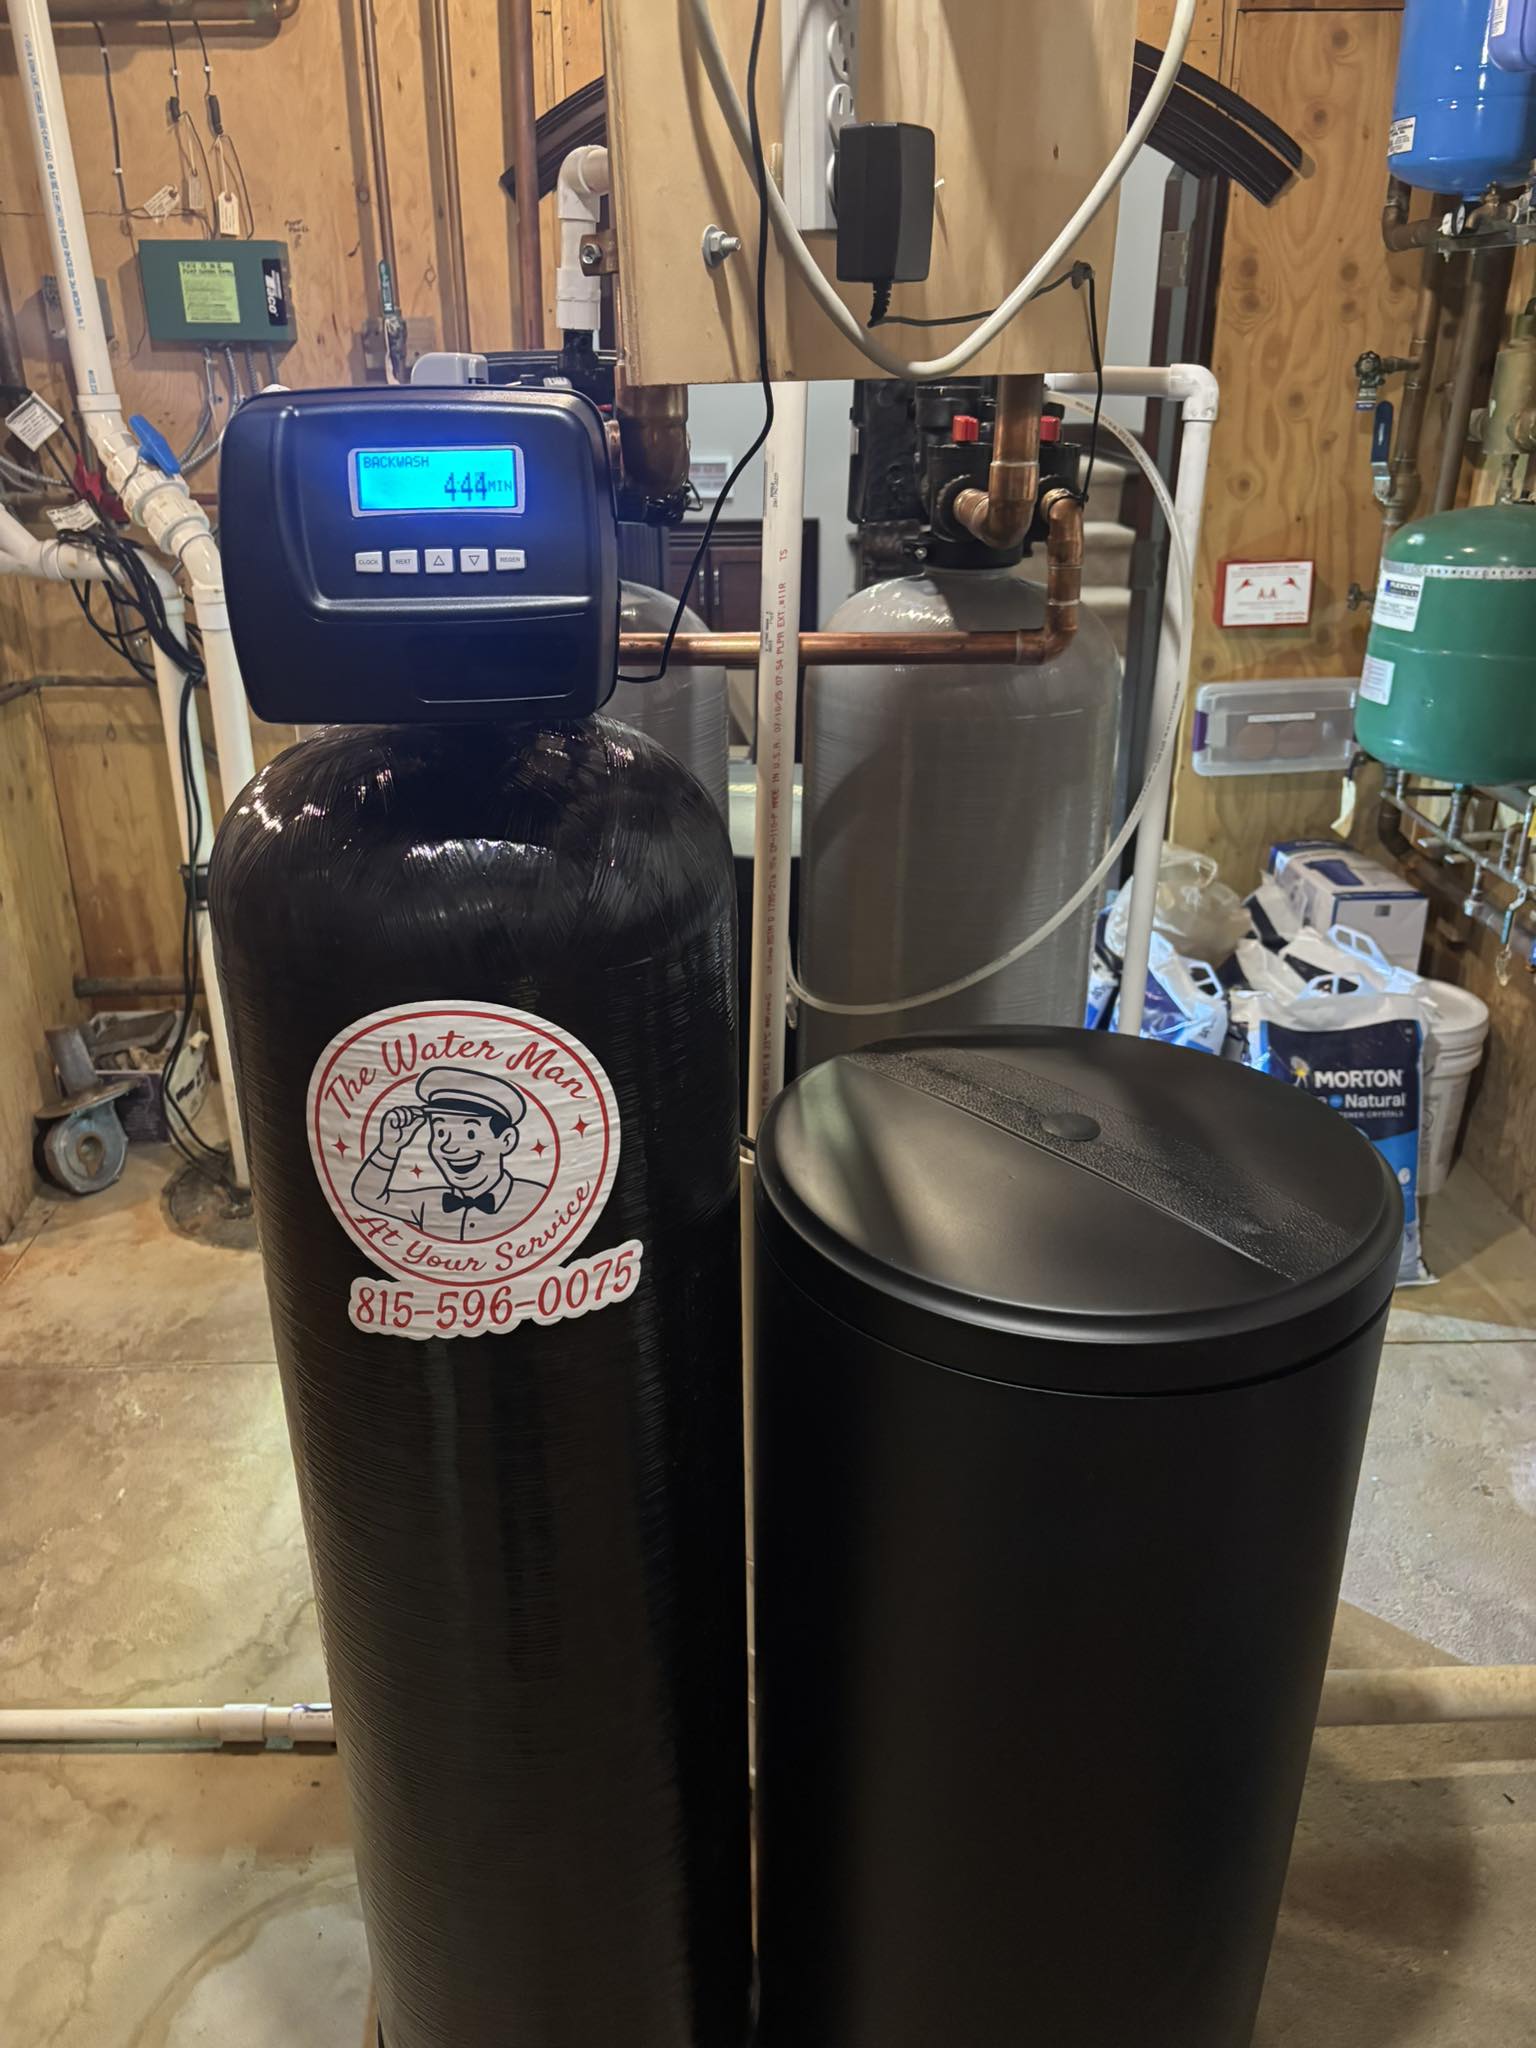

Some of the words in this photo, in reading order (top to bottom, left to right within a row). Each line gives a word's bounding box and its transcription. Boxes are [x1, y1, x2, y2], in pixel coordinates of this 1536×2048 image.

[363, 455, 430, 469] BACKWASH
[488, 479, 512, 493] MIN
[499, 556, 521, 564] REGEN
[325, 1067, 377, 1120] The
[381, 1030, 505, 1077] Water
[505, 1041, 588, 1100] Man
[1314, 1068, 1402, 1089] MORTON
[1345, 1092, 1405, 1109] Natural
[355, 1213, 403, 1248] At
[402, 1240, 487, 1274] Your
[495, 1180, 591, 1272] Service
[355, 1249, 636, 1330] 815-596-0075
